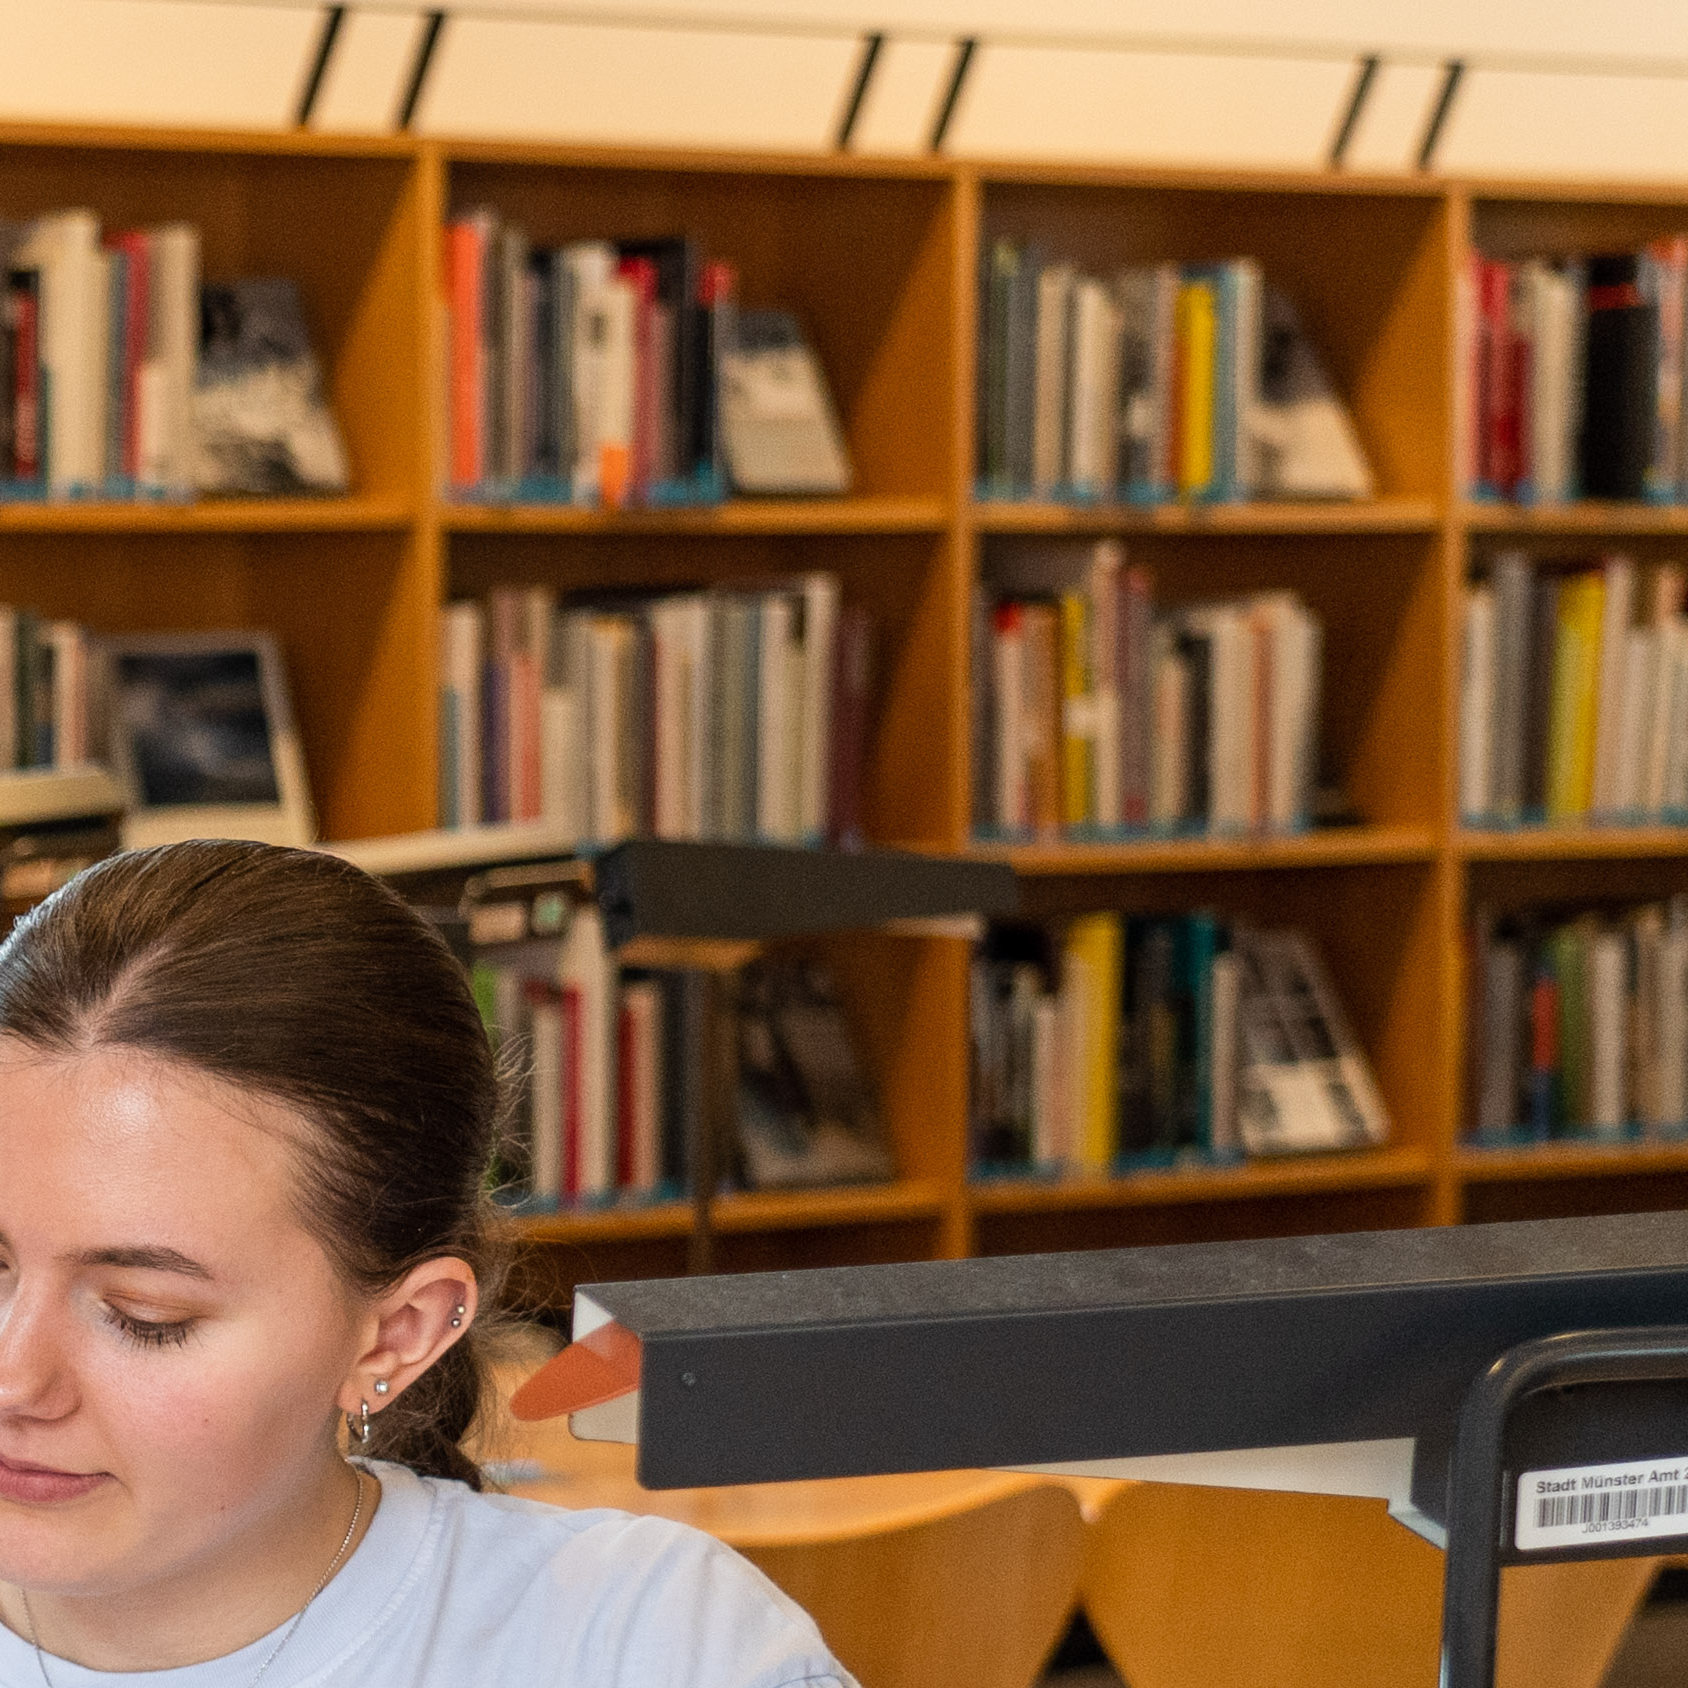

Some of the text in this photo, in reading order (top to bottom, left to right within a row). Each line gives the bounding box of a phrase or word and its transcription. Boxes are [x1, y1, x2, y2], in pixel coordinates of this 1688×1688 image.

[1536, 1479, 1577, 1493] Stadt
[1581, 1473, 1644, 1489] Münster
[1648, 1469, 1680, 1482] Amt
[1581, 1518, 1649, 1534] J001393474
